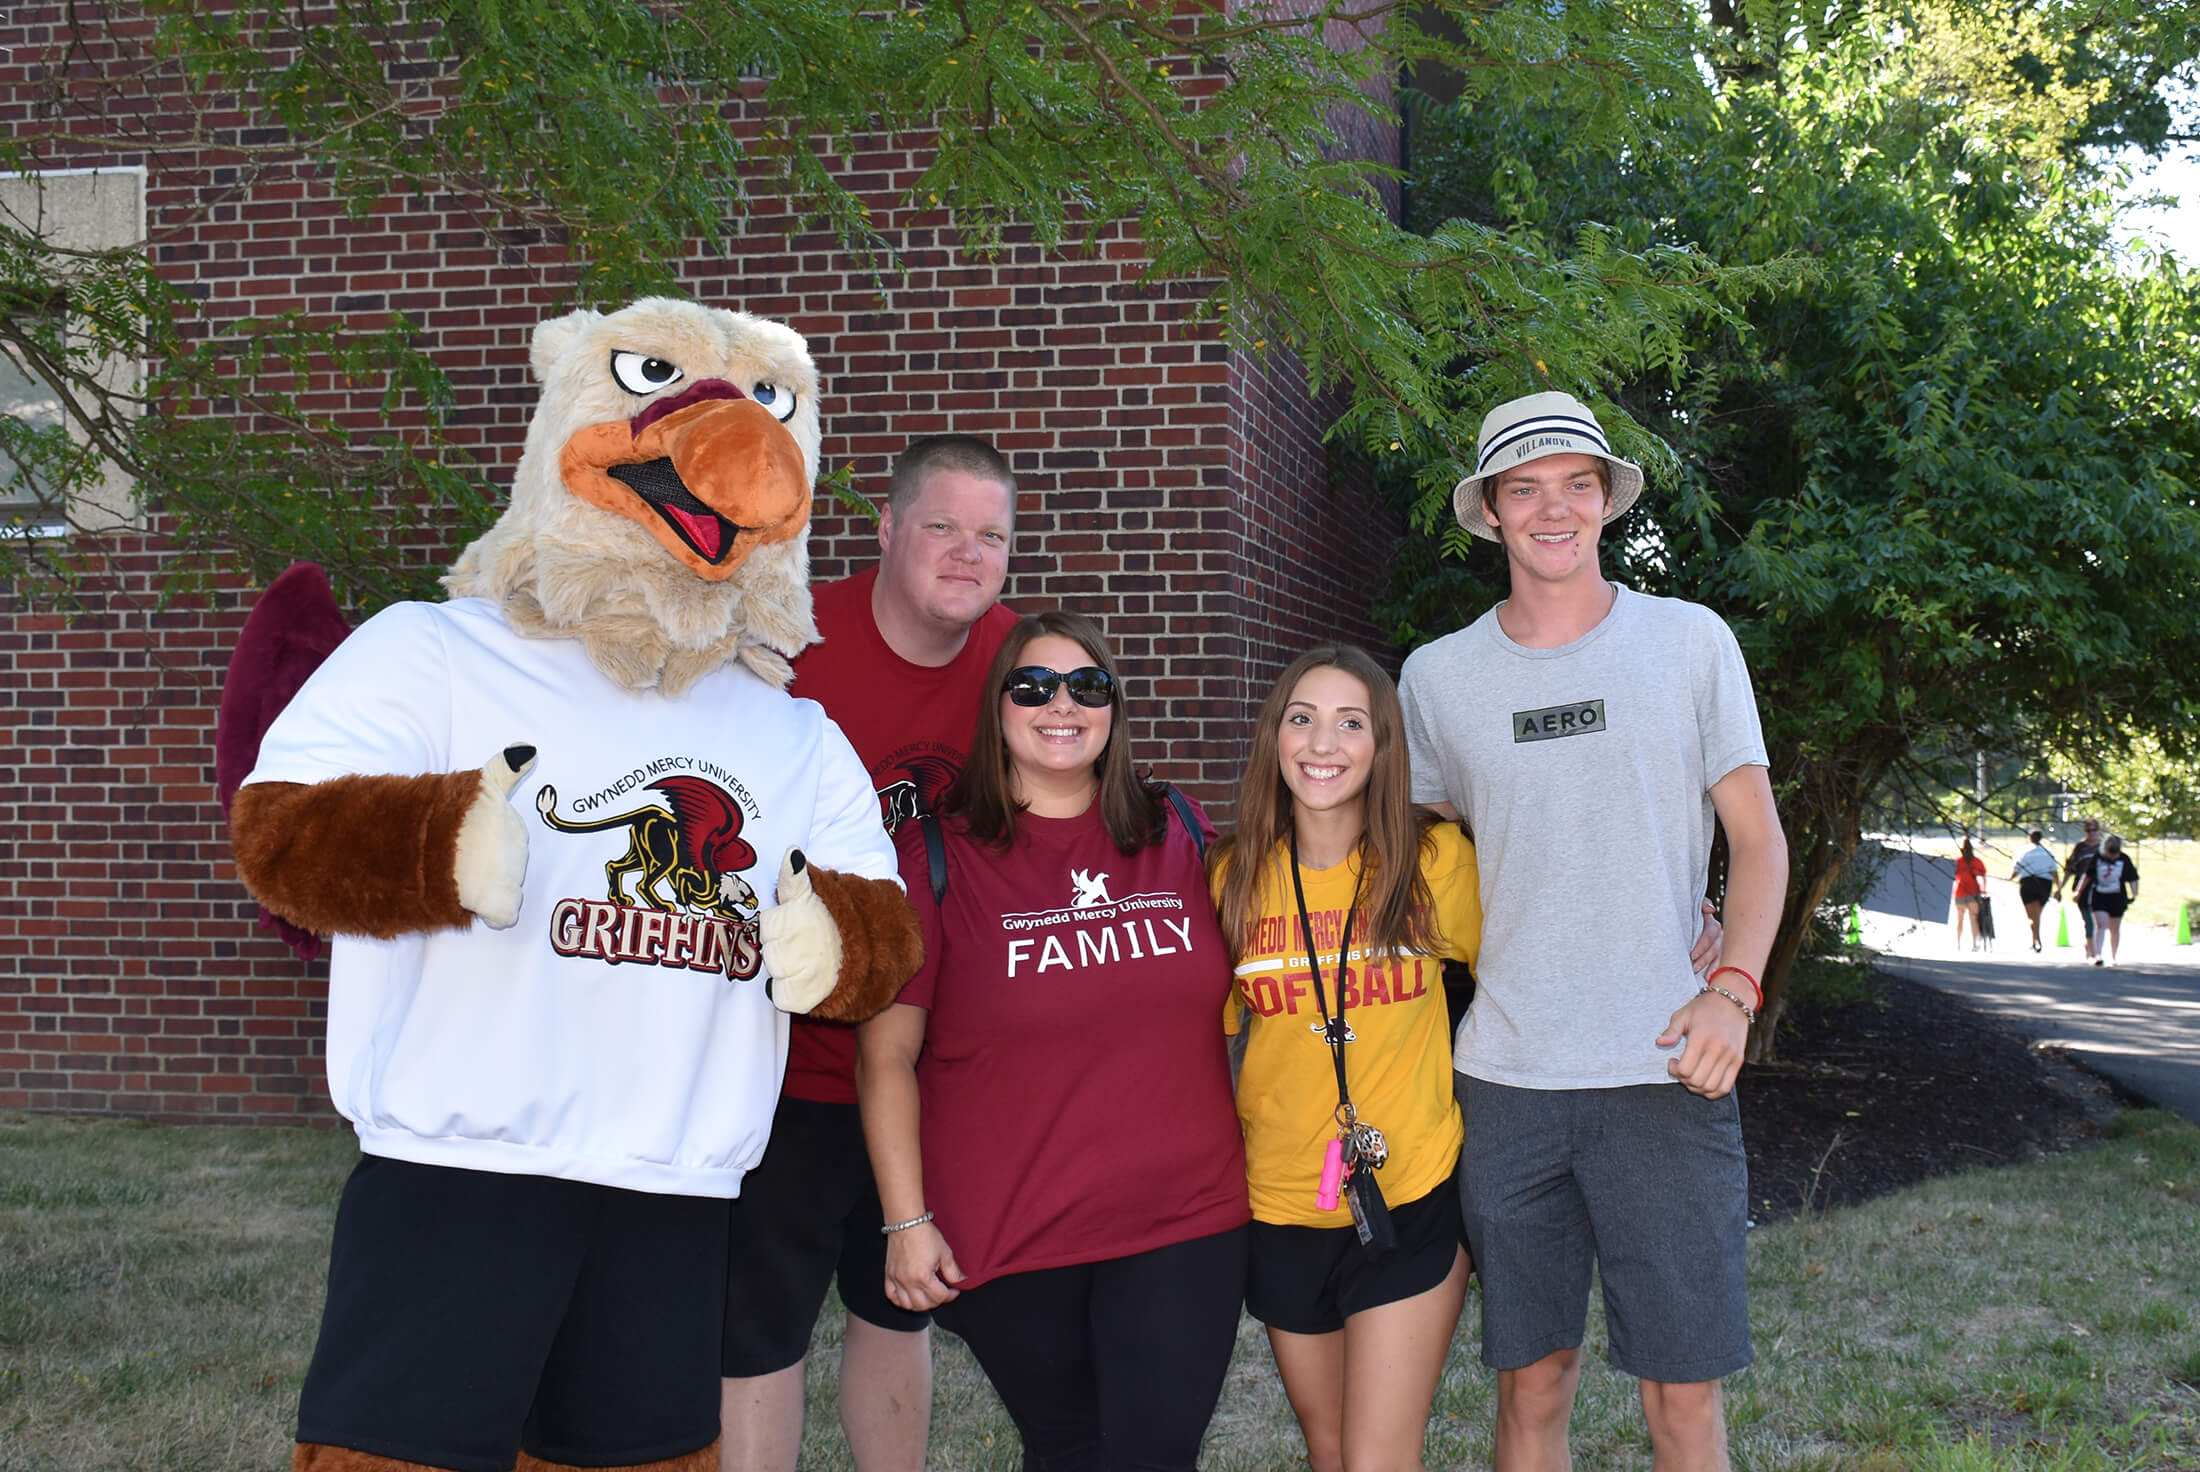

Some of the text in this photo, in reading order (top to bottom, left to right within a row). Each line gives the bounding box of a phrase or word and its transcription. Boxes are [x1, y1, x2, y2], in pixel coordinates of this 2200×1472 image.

[1516, 437, 1572, 459] VILLANOVA
[1522, 708, 1597, 735] AERO
[572, 756, 762, 821] GWYNEDD MERCY UNIVERSITY
[1002, 897, 1183, 931] Gwynedd Mercy University
[550, 898, 762, 981] GRIFFINS
[1007, 916, 1193, 978] FAMILY
